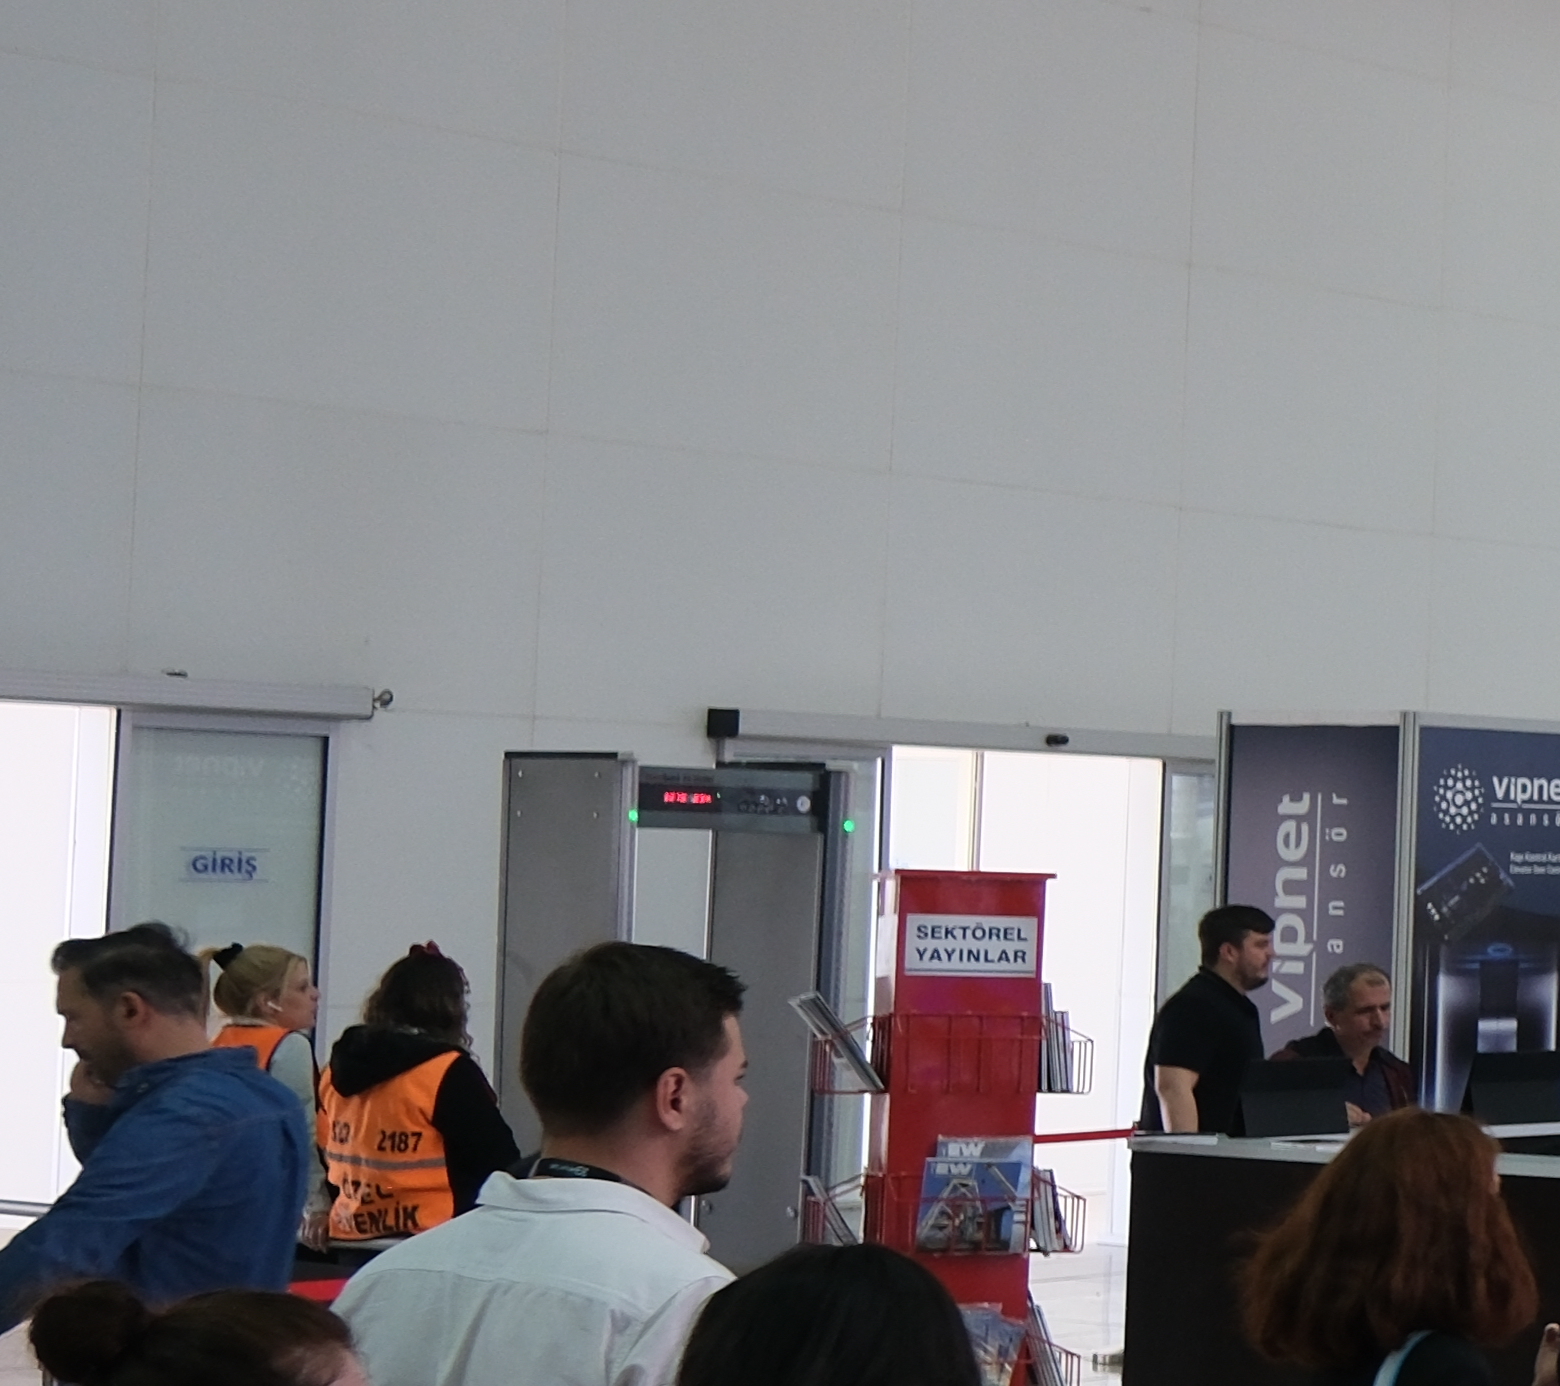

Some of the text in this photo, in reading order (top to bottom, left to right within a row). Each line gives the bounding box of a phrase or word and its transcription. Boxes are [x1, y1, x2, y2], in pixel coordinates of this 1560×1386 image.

[191, 850, 257, 881] GİRİŞ
[1326, 792, 1348, 955] ansör
[1271, 791, 1311, 1025] vipnet
[916, 921, 1029, 943] SEKTÖREL
[915, 946, 1028, 965] YAYINLAR
[377, 1129, 422, 1154] 2187
